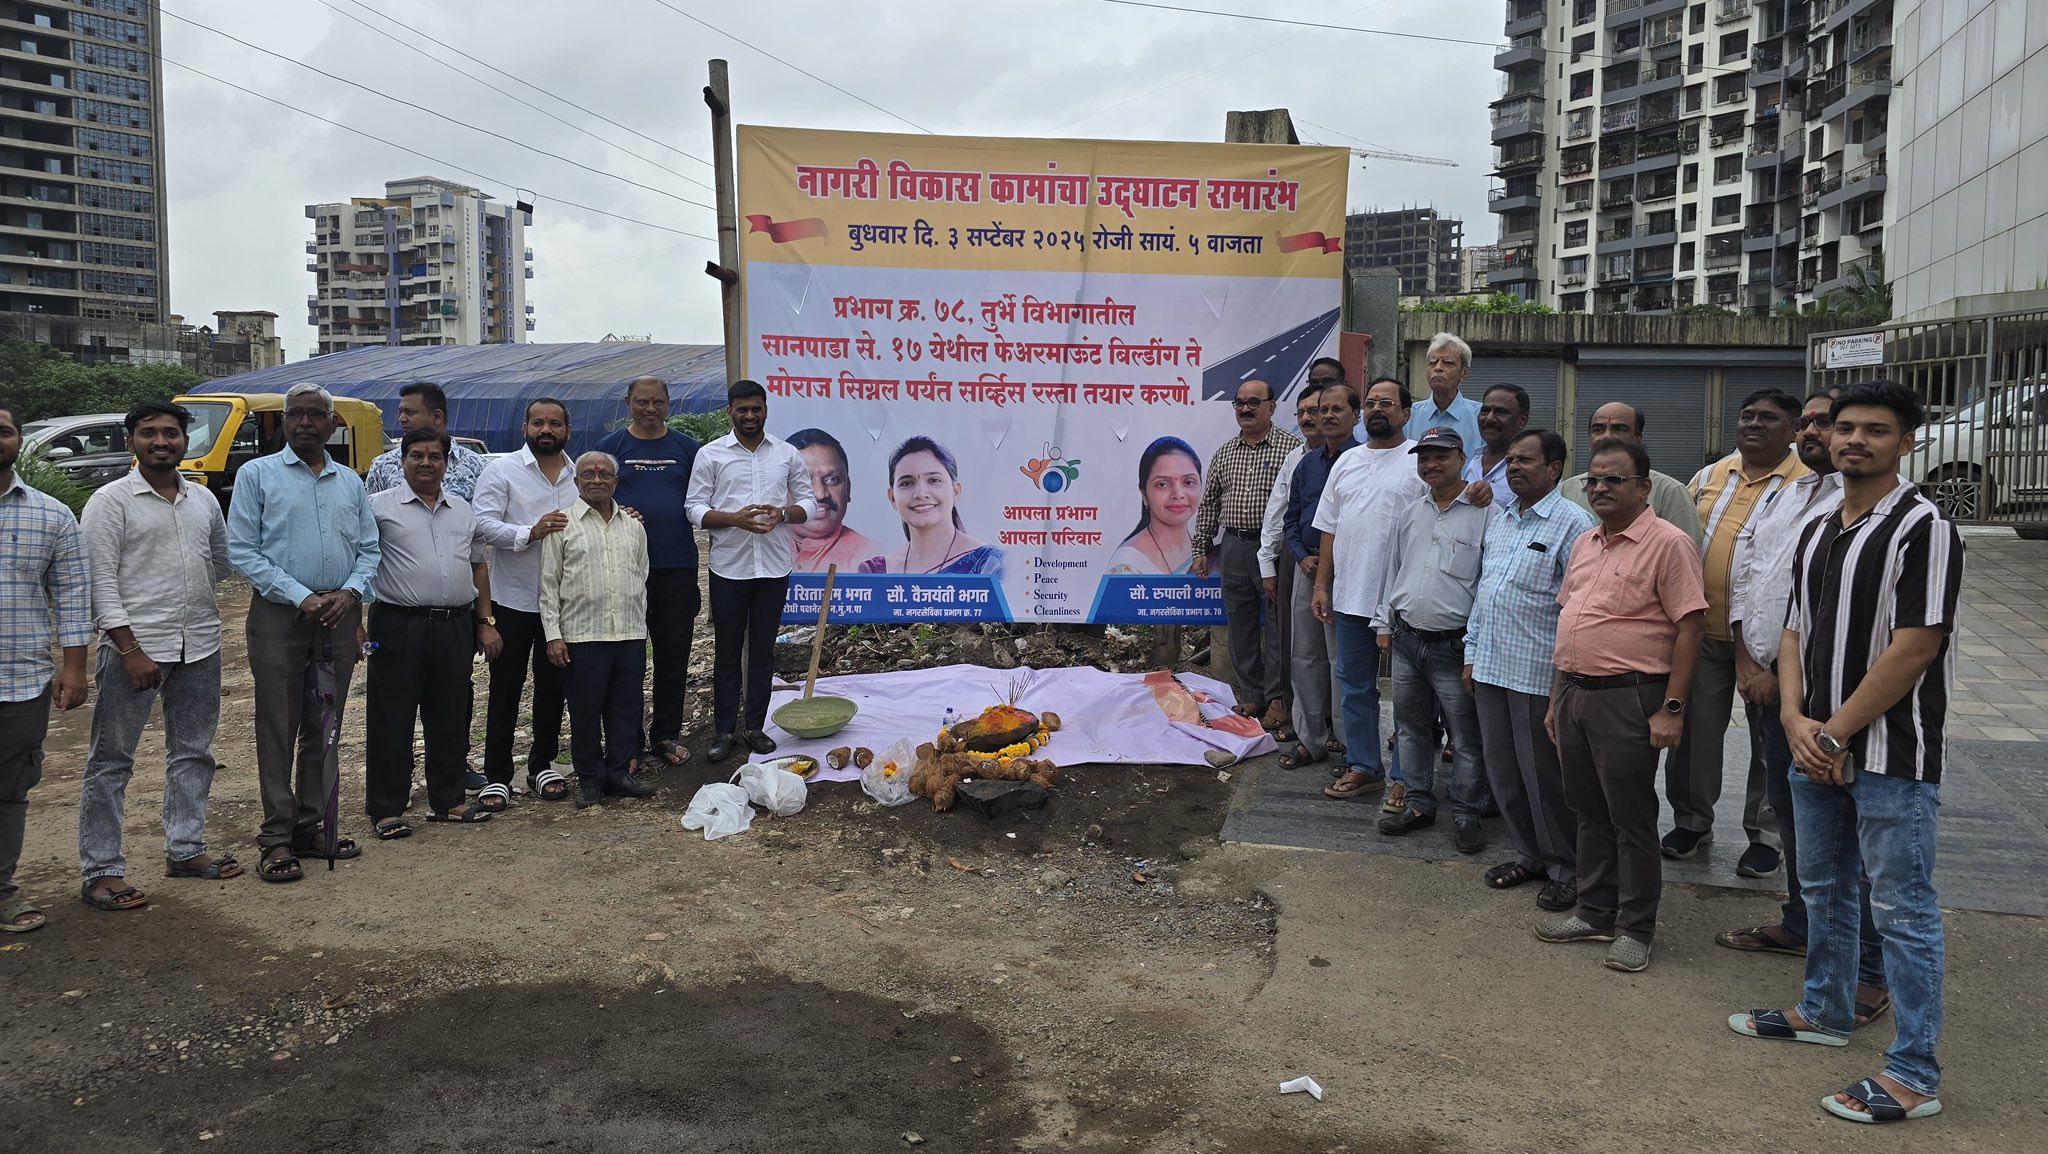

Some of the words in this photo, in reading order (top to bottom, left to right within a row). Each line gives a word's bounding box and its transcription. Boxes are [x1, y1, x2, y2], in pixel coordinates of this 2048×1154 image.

[797, 158, 880, 199] नागरी
[888, 160, 982, 203] विकास
[989, 161, 1090, 206] कामांचा
[1096, 175, 1200, 219] उद्घाटन
[1206, 168, 1300, 212] समारंभ
[848, 223, 908, 251] बुधवार
[914, 218, 939, 246] दि.
[948, 227, 959, 249] ३
[967, 221, 1025, 248] सप्टेंबर
[1033, 229, 1085, 252] २०२५
[1092, 224, 1133, 251] रोजी
[1139, 225, 1180, 252] सायं.
[1188, 233, 1199, 255] ५
[1207, 235, 1263, 254] वाजता
[833, 295, 893, 320] प्रभाग
[898, 299, 926, 322] क्र.
[934, 298, 974, 325] ७८,
[981, 293, 1017, 333] तुर्भे
[1022, 294, 1136, 326] विभागातील
[1847, 336, 1872, 345] PARKING
[761, 334, 850, 359] सानपाडा
[855, 330, 881, 360] से.
[892, 336, 922, 362] १७
[929, 332, 989, 363] येथील
[994, 333, 1103, 365] फेअरमाऊंट
[1108, 336, 1180, 366] बिल्डींग
[1186, 337, 1202, 367] ते
[766, 367, 832, 398] मोराज
[838, 370, 900, 401] सिग्नल
[905, 371, 953, 402] पर्यंत
[958, 373, 1026, 408] सर्व्हिस
[1032, 383, 1077, 404] रस्ता
[1083, 384, 1134, 406] तयार
[1140, 377, 1195, 406] करणे.
[1002, 506, 1052, 521] आपला
[1056, 505, 1098, 520] प्रभाग
[998, 530, 1047, 546] आपला
[1051, 526, 1102, 546] परिवार
[1034, 557, 1088, 569] Development
[1034, 573, 1059, 584] Peace
[846, 587, 872, 601] भगत
[886, 585, 908, 602] सौ.
[911, 585, 955, 603] वैजयंती
[959, 588, 989, 602] भगत
[1033, 588, 1068, 602] Security
[1129, 584, 1149, 600] सौ.
[1152, 584, 1192, 600] रुपाली
[1195, 587, 1222, 599] भगत
[782, 602, 797, 614] रोधी
[893, 608, 904, 616] मा.
[906, 606, 942, 617] नगरसेविका
[944, 608, 962, 617] प्रभाग
[963, 608, 972, 617] क्र.
[974, 608, 982, 617] 77
[1034, 604, 1081, 616] Cleanliness
[1137, 608, 1148, 616] मा.
[1150, 607, 1184, 616] नगरसेविका
[1186, 608, 1202, 616] प्रभाग
[1204, 608, 1212, 616] क्र.
[1213, 608, 1222, 616] 78
